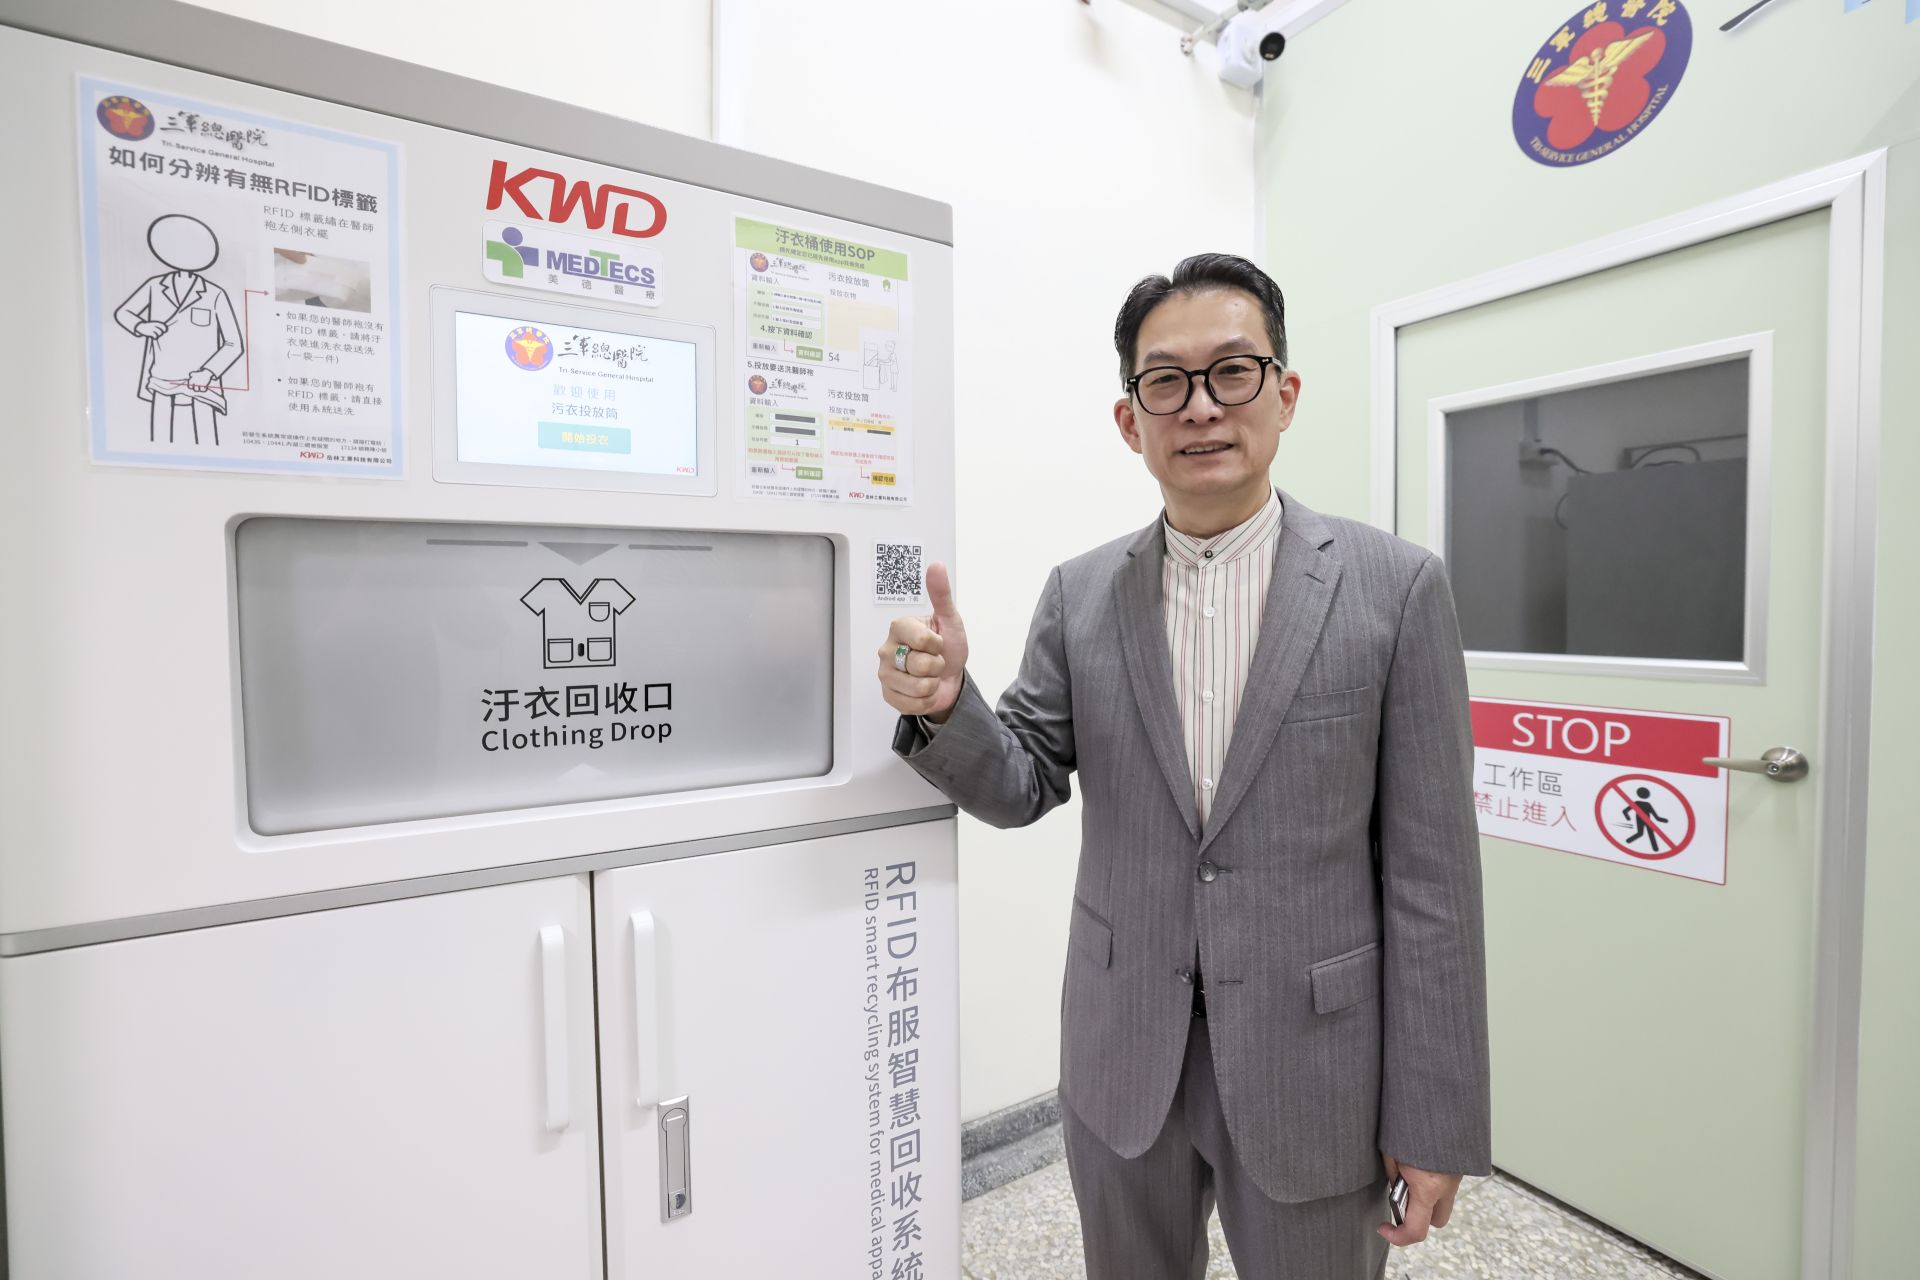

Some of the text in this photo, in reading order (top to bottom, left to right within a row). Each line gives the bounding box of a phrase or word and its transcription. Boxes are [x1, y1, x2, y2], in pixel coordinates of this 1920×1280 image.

[1575, 134, 1628, 162] GENERAL
[1626, 83, 1669, 135] HOSPITAL
[161, 140, 275, 168] Tri-Service General Hospital
[109, 145, 379, 214] 如何分辨有無RFID標籤
[486, 159, 668, 239] KWD
[264, 205, 294, 219] RFID
[546, 248, 656, 286] MEDTECS
[286, 324, 313, 335] RFID
[598, 371, 625, 380] General
[626, 374, 654, 383] Hospital
[829, 352, 840, 363] 54
[288, 389, 314, 400] RFID
[481, 722, 672, 752] Clothing Drop
[1512, 712, 1631, 757] STOP
[1483, 763, 1563, 797] 工作區
[1473, 791, 1577, 832] 禁止進入
[864, 867, 880, 911] RFID
[865, 915, 880, 972] smart
[863, 974, 883, 1061] recycling
[864, 1062, 882, 1128] system
[869, 1129, 885, 1155] for
[870, 1159, 886, 1234] medical
